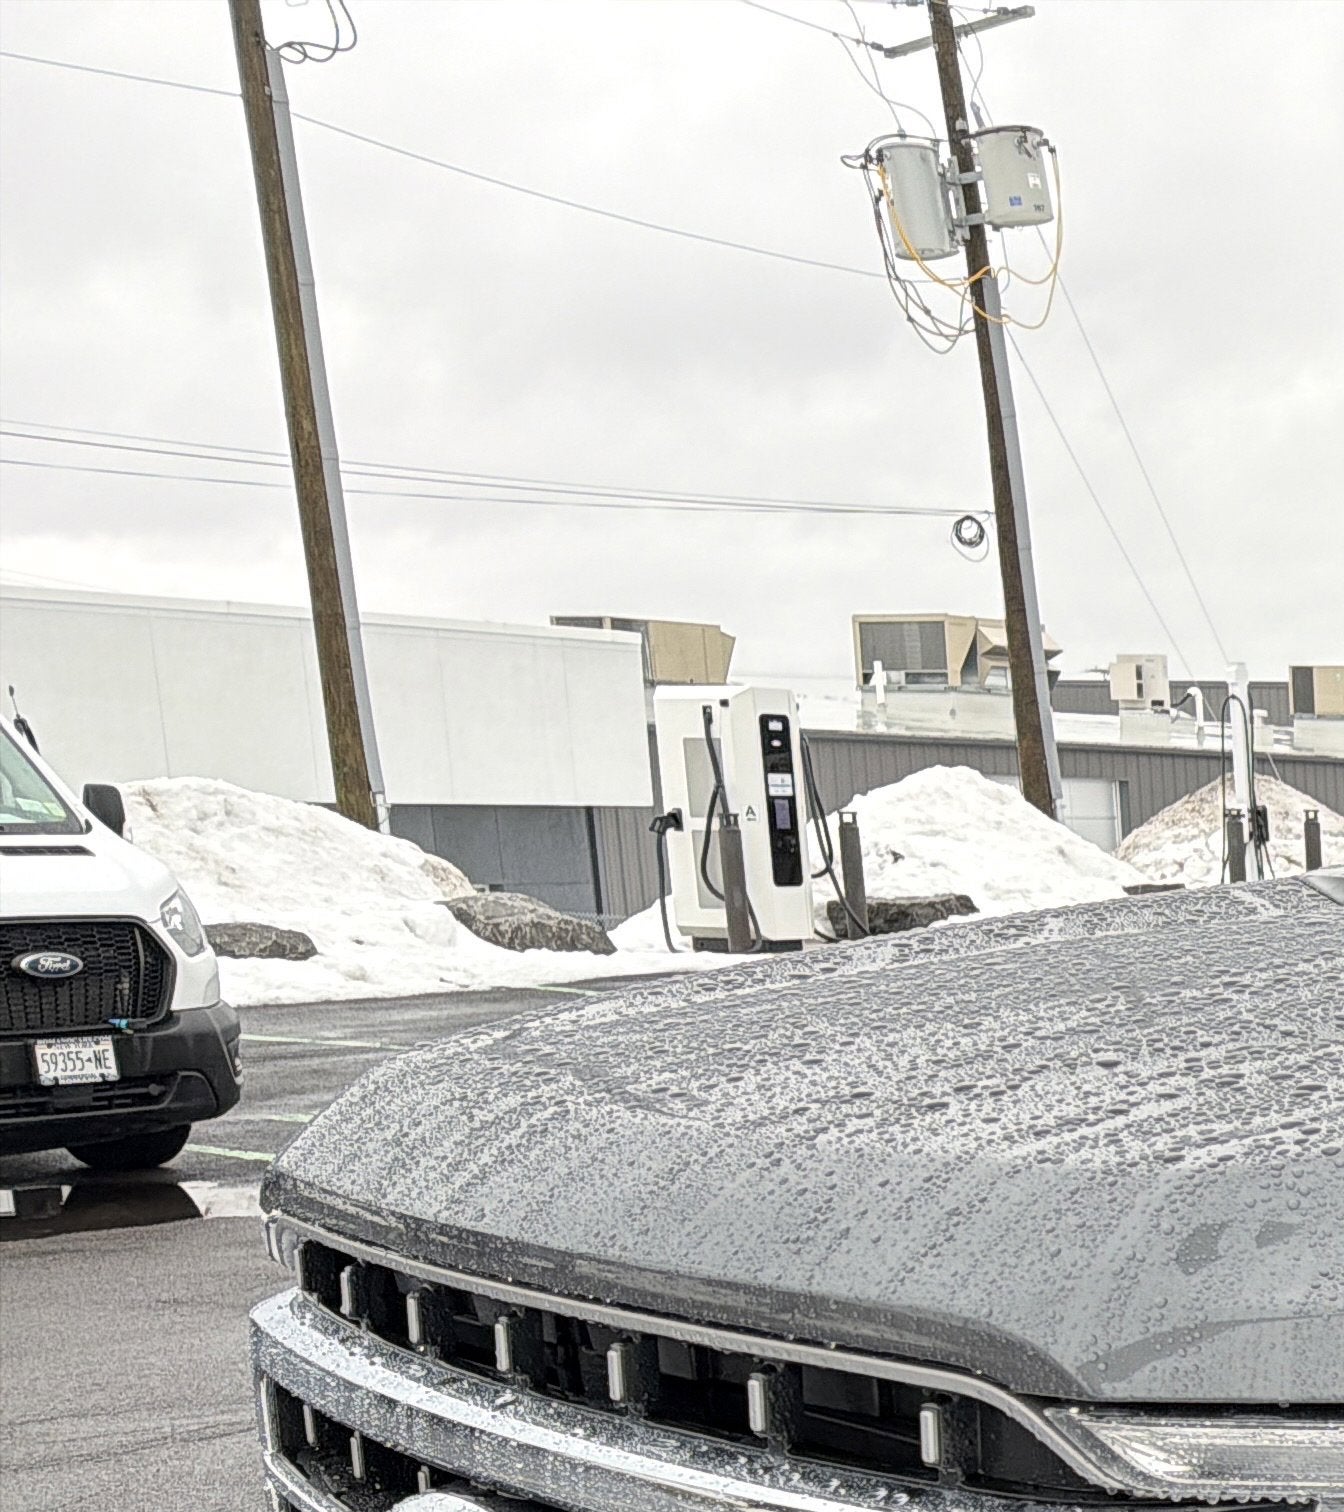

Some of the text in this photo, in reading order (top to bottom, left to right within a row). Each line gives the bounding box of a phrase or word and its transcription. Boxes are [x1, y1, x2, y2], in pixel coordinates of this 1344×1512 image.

[37, 956, 71, 972] Ford
[41, 1049, 112, 1074] 59355 NE
